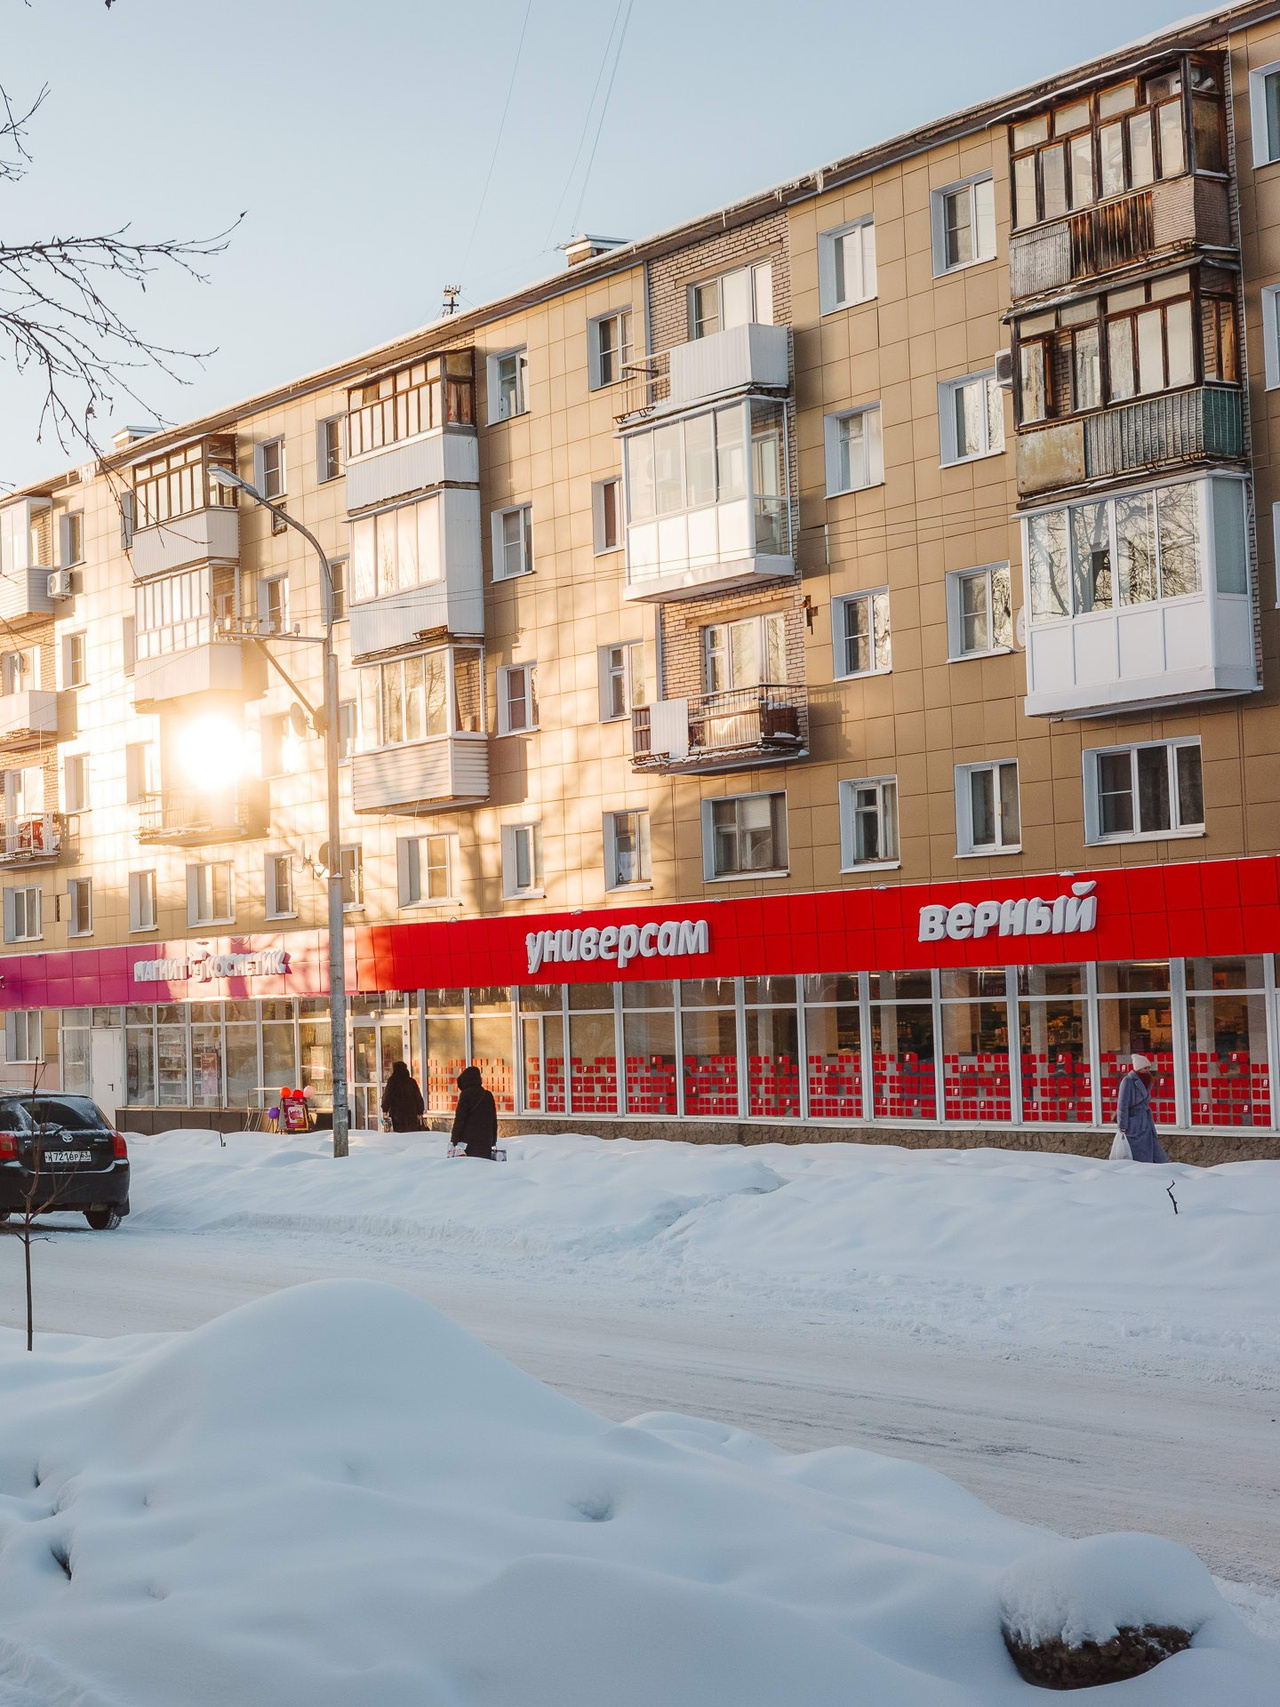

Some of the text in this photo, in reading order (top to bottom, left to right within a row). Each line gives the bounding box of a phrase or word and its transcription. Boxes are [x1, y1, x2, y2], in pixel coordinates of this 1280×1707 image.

[918, 880, 1097, 942] верный
[134, 950, 286, 982] МАГНИТ КОСМЕТИК
[526, 920, 709, 974] универсам
